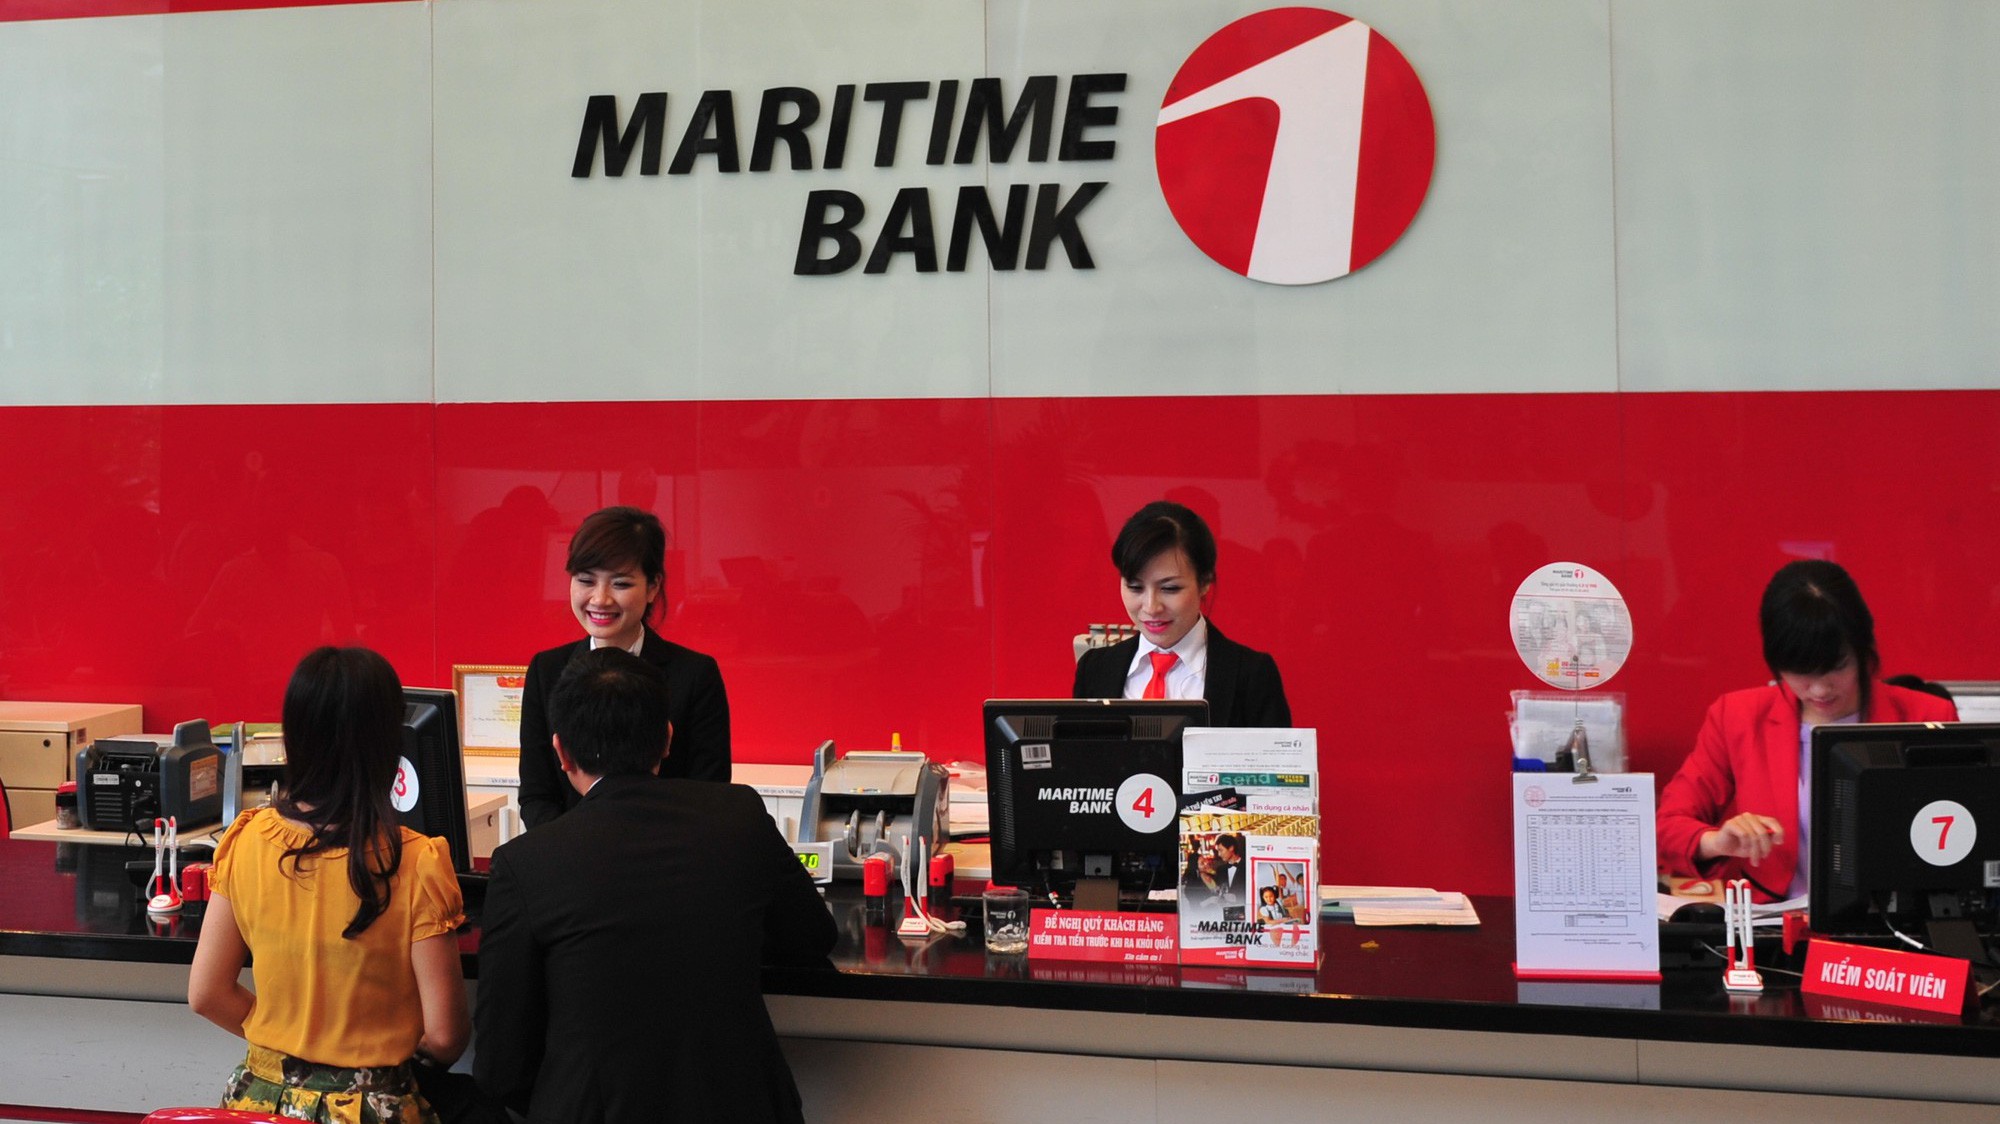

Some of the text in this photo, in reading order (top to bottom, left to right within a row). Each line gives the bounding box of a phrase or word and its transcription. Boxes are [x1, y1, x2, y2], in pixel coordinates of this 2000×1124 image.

[571, 73, 1128, 178] MARITIME
[793, 182, 1109, 276] BANK
[395, 767, 407, 797] 3
[1221, 773, 1271, 786] send
[1038, 788, 1114, 801] MARITIME
[1132, 787, 1155, 818] 4
[1069, 801, 1112, 814] BANK
[1931, 816, 1955, 850] 7
[1059, 917, 1081, 932] NGHỊ
[1083, 916, 1102, 933] QUÝ
[1104, 916, 1136, 931] KHÁCH
[1198, 921, 1265, 933] MARITIME
[1053, 935, 1067, 946] TRA
[1124, 938, 1134, 948] RA
[1225, 934, 1263, 946] BANK
[1820, 957, 1947, 1000] KIỂM SOÁT VIÊN
